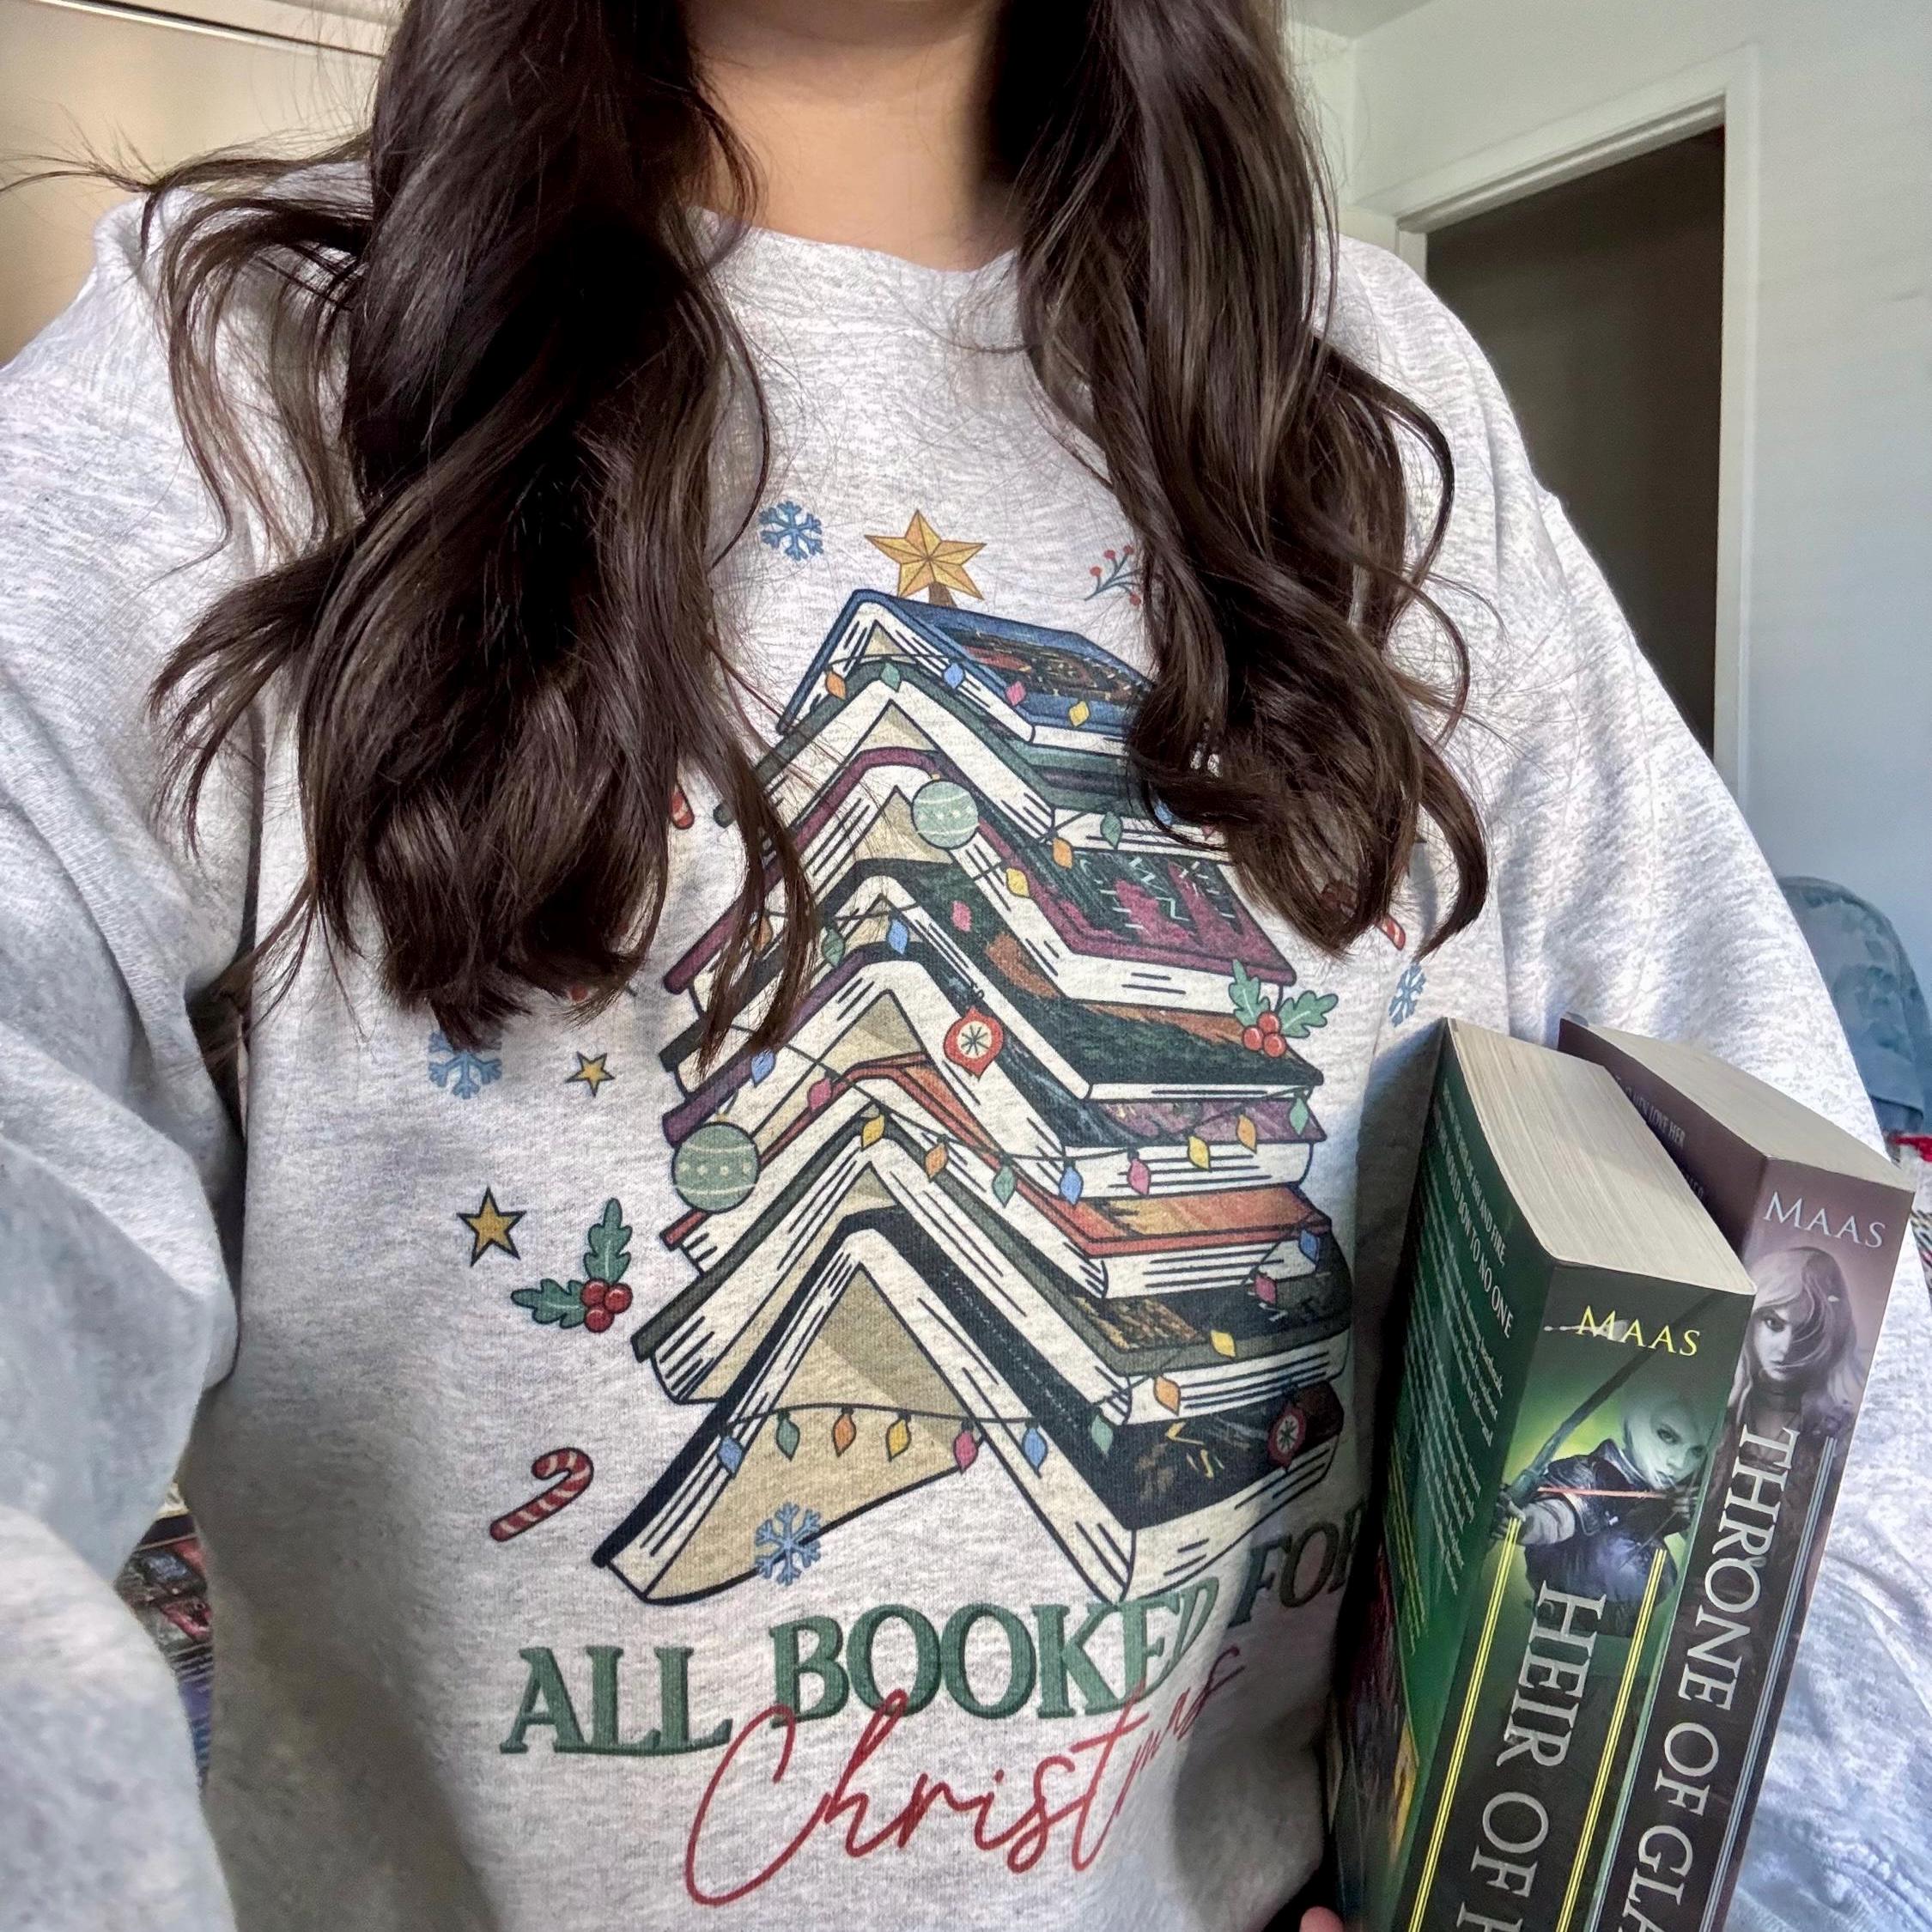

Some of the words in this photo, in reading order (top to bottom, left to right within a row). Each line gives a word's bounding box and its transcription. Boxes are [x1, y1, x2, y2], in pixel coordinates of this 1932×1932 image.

[1668, 1120, 1687, 1150] HER
[1478, 1197, 1493, 1232] AND
[1762, 1190, 1886, 1249] MAAS
[1469, 1226, 1480, 1262] TO
[1478, 1253, 1492, 1292] NO
[1492, 1285, 1514, 1339] ONE
[1575, 1304, 1701, 1357] MAAS
[1677, 1423, 1801, 1711] THRONE
[498, 1644, 733, 1759] ALL
[768, 1576, 1220, 1728] BOOKED
[1495, 1579, 1607, 1767] HEIR
[685, 1645, 1246, 1907] Christmas
[1654, 1721, 1720, 1817] OF
[1469, 1791, 1550, 1899] OF
